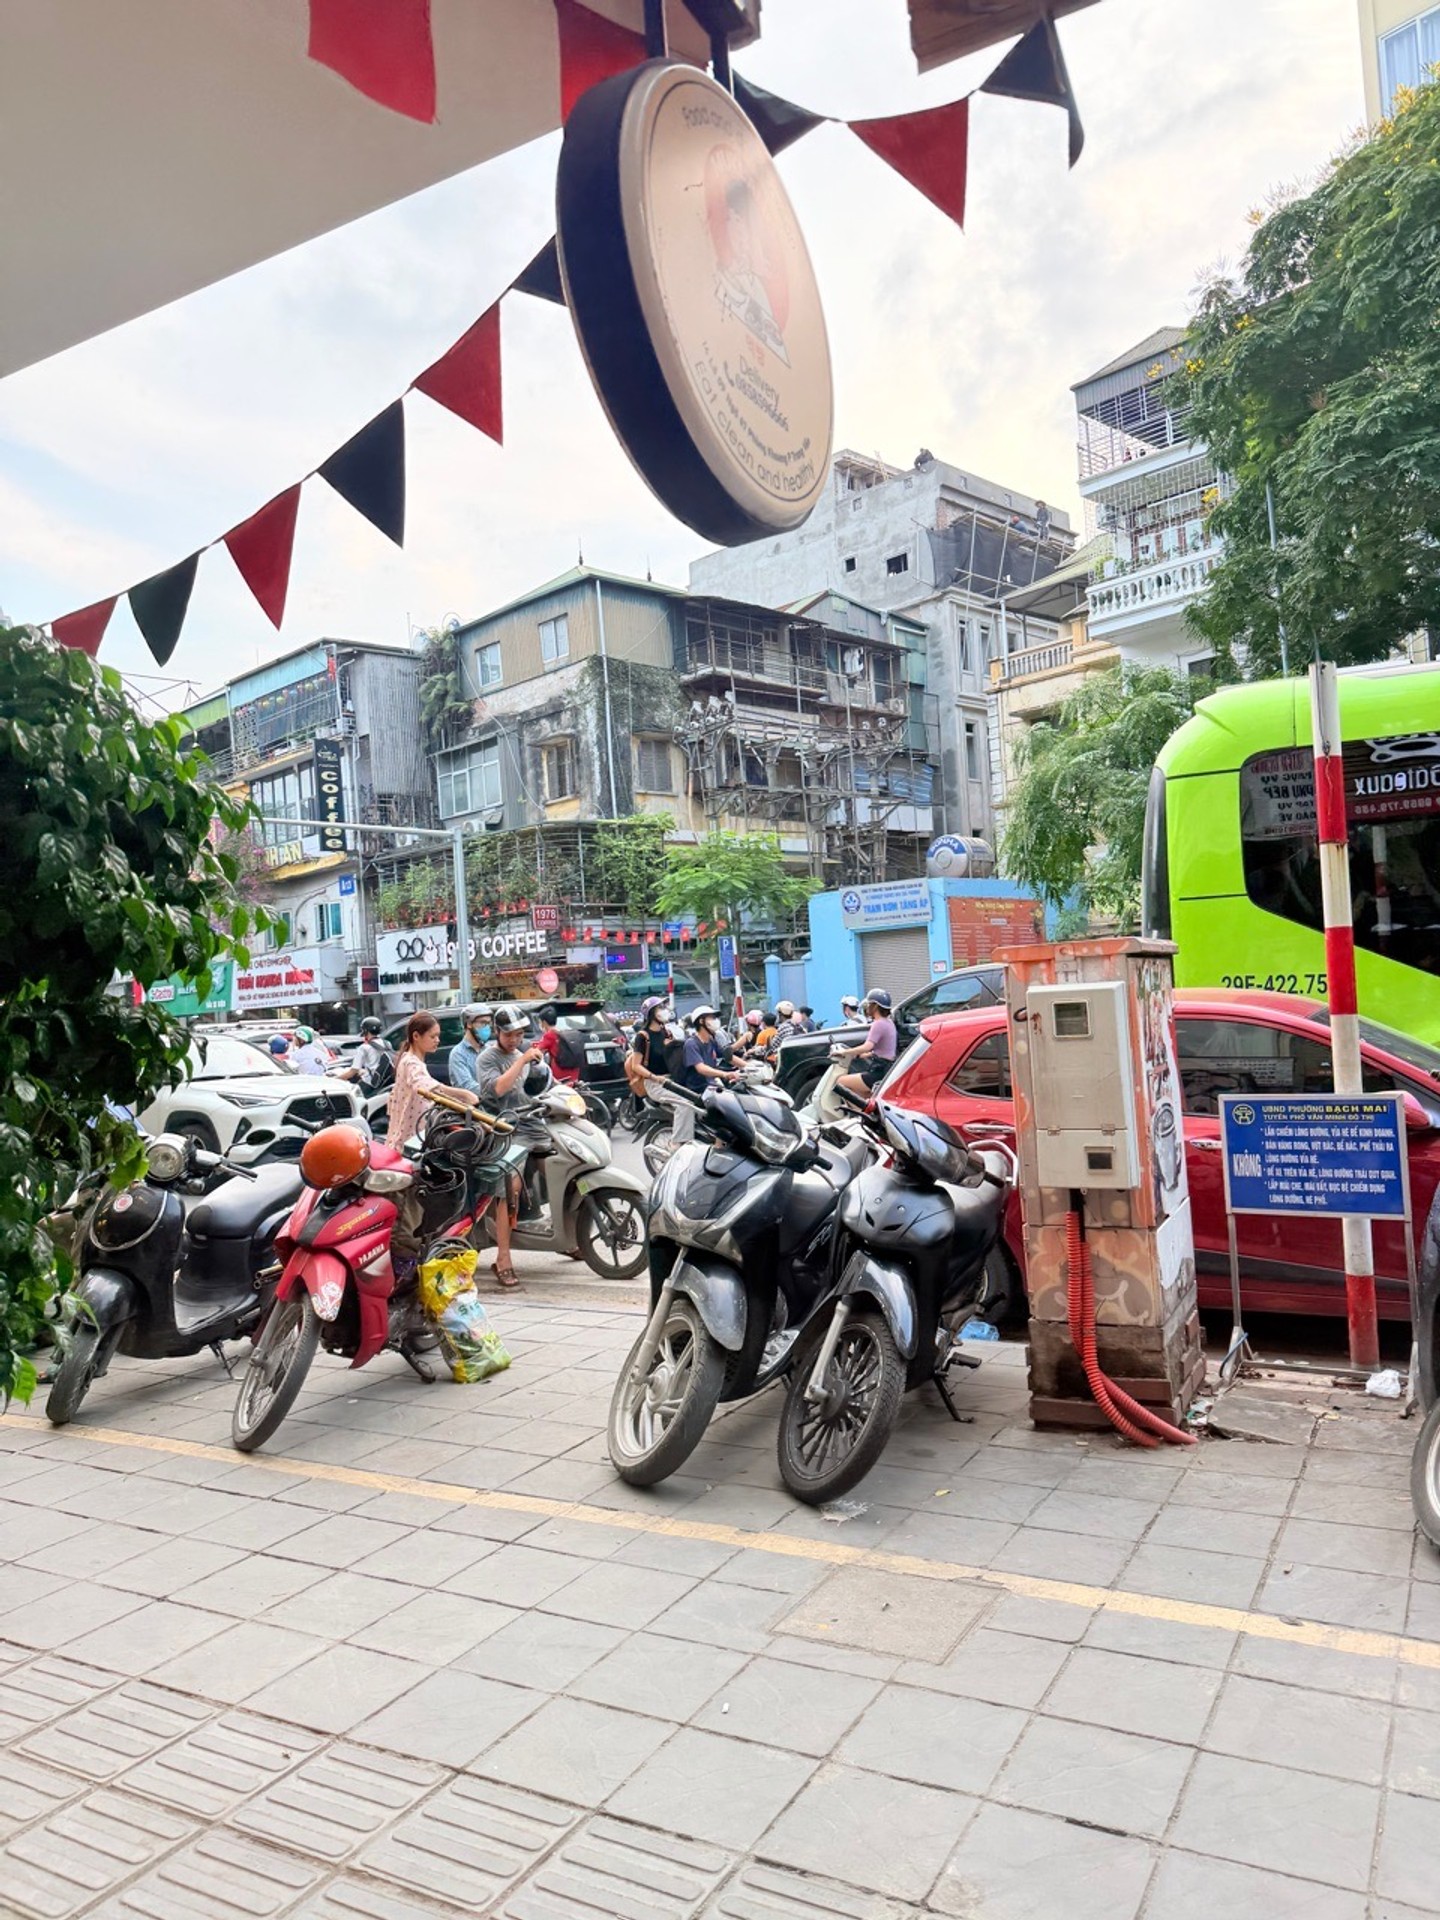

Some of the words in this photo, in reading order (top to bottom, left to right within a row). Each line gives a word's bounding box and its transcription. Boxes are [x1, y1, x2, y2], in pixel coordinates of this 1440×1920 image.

[740, 354, 780, 413] Delivery
[717, 410, 755, 469] clean
[757, 463, 781, 491] and
[536, 909, 556, 920] 1978
[481, 930, 548, 960] COFFEE
[723, 938, 729, 951] P
[1261, 1105, 1286, 1113] UBND
[1325, 1105, 1359, 1114] BẠCH
[1363, 1105, 1388, 1113] MAI
[1232, 1148, 1263, 1178] KHÔNG
[358, 1243, 385, 1265] YAMAHA
